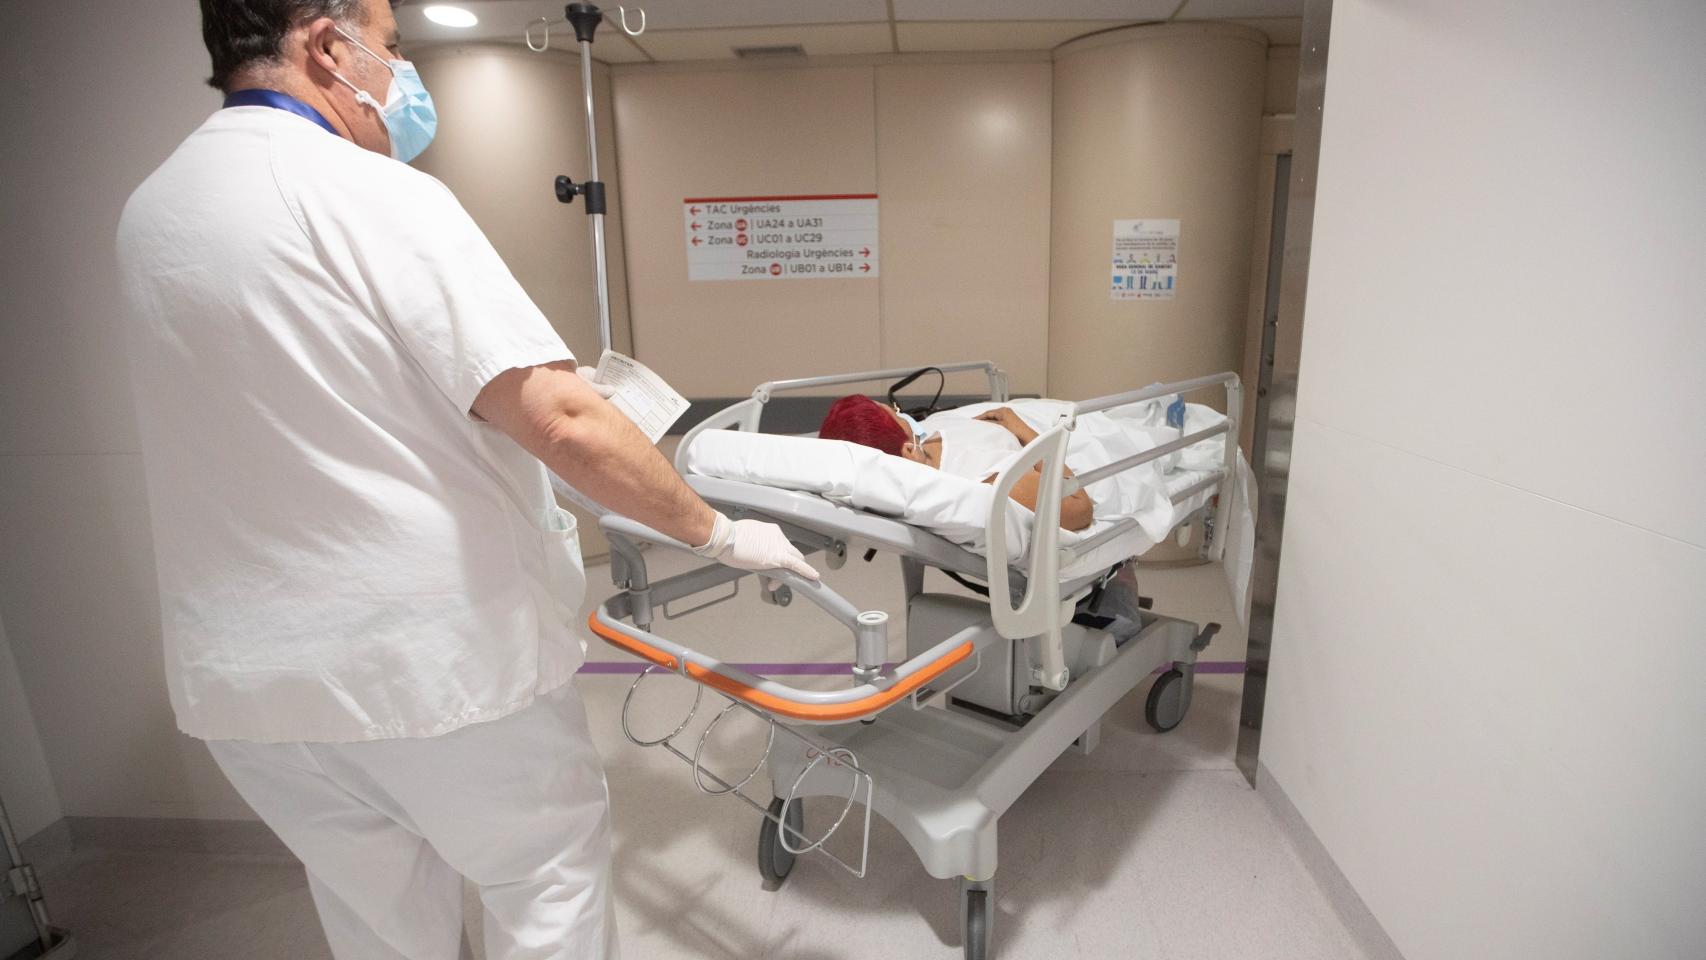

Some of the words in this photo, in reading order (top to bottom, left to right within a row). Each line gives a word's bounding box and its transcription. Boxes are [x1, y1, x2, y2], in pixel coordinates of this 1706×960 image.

[706, 205, 727, 215] TAC
[708, 220, 732, 230] Zona
[756, 218, 785, 229] UA24
[797, 217, 823, 228] UA31
[708, 236, 733, 245] Zona
[757, 234, 783, 244] UC01
[795, 232, 823, 243] UC29
[742, 265, 766, 274] Zona
[790, 264, 816, 273] UB01
[828, 262, 854, 273] UB14
